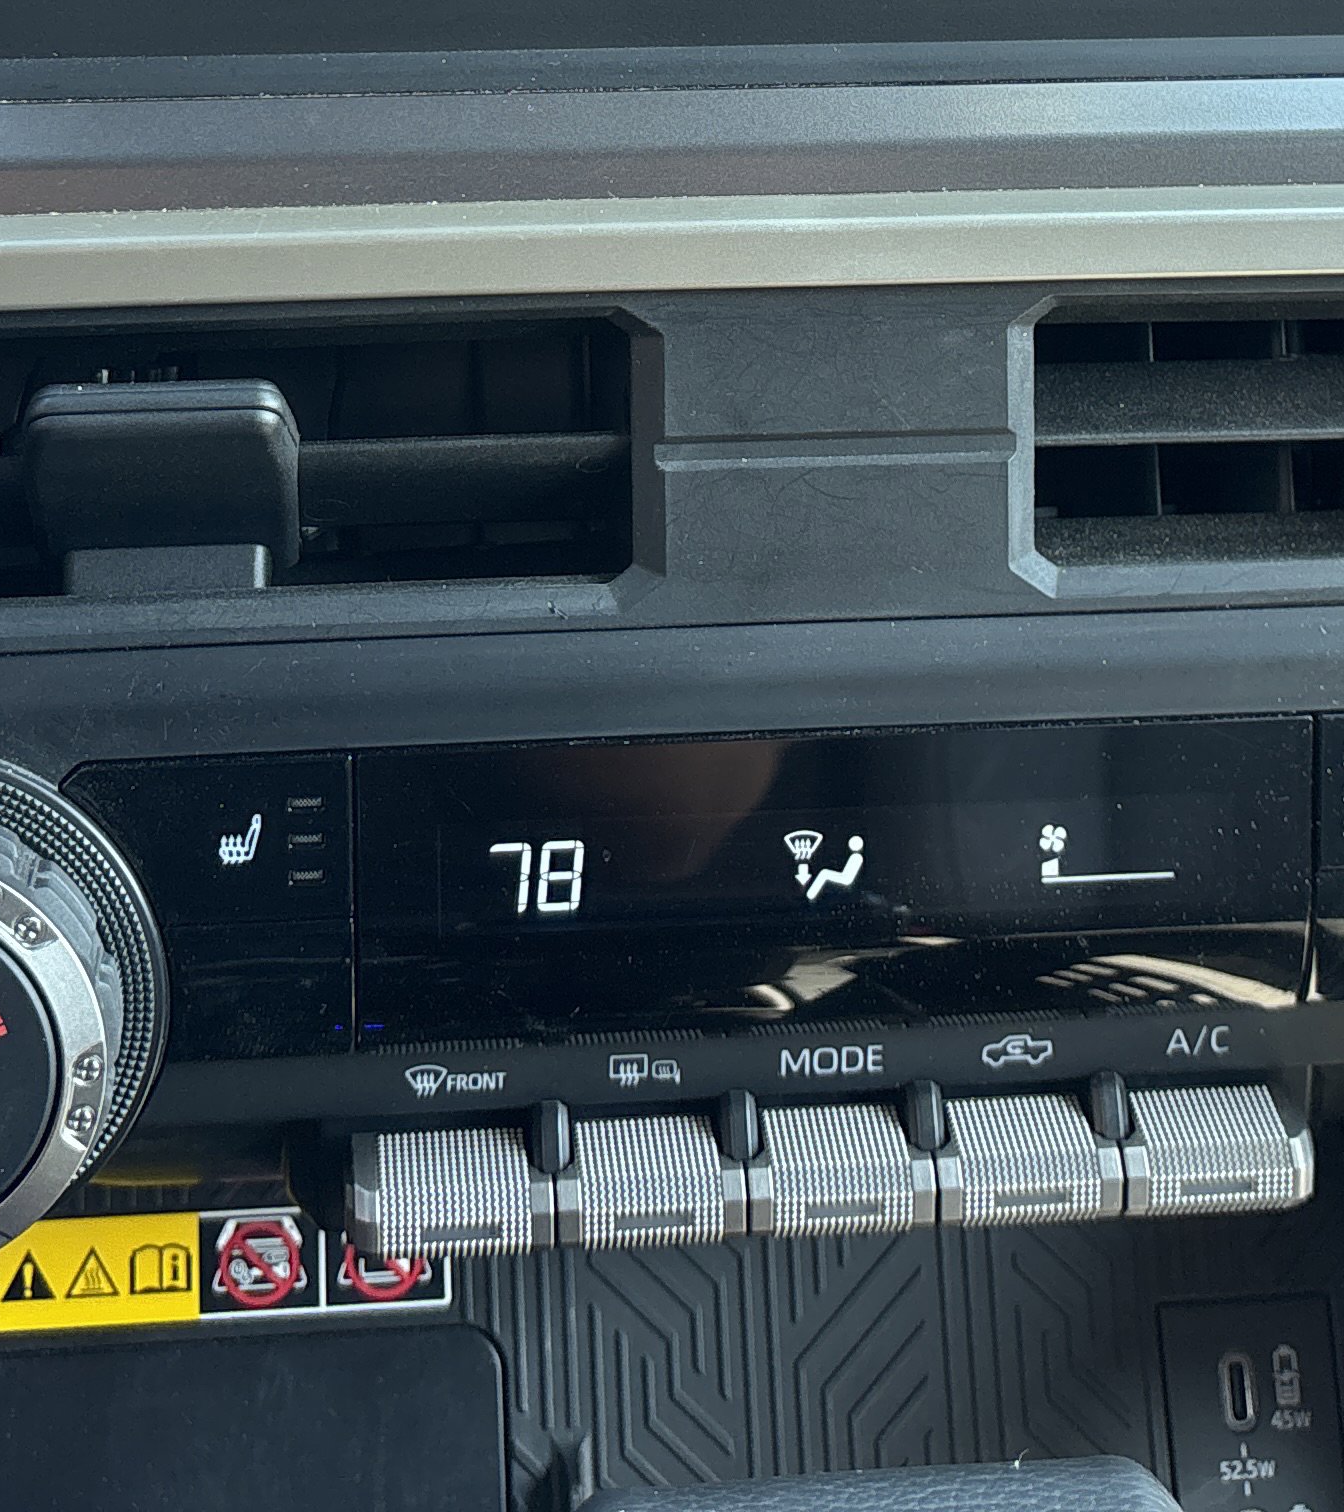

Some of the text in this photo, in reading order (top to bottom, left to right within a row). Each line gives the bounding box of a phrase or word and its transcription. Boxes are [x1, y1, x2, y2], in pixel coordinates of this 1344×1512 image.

[490, 839, 585, 912] 78
[1165, 1024, 1231, 1058] A/C
[779, 1044, 884, 1076] MODE
[446, 1069, 506, 1092] FRONT
[1271, 1409, 1312, 1429] 45W
[1219, 1459, 1276, 1481] 52.5W
